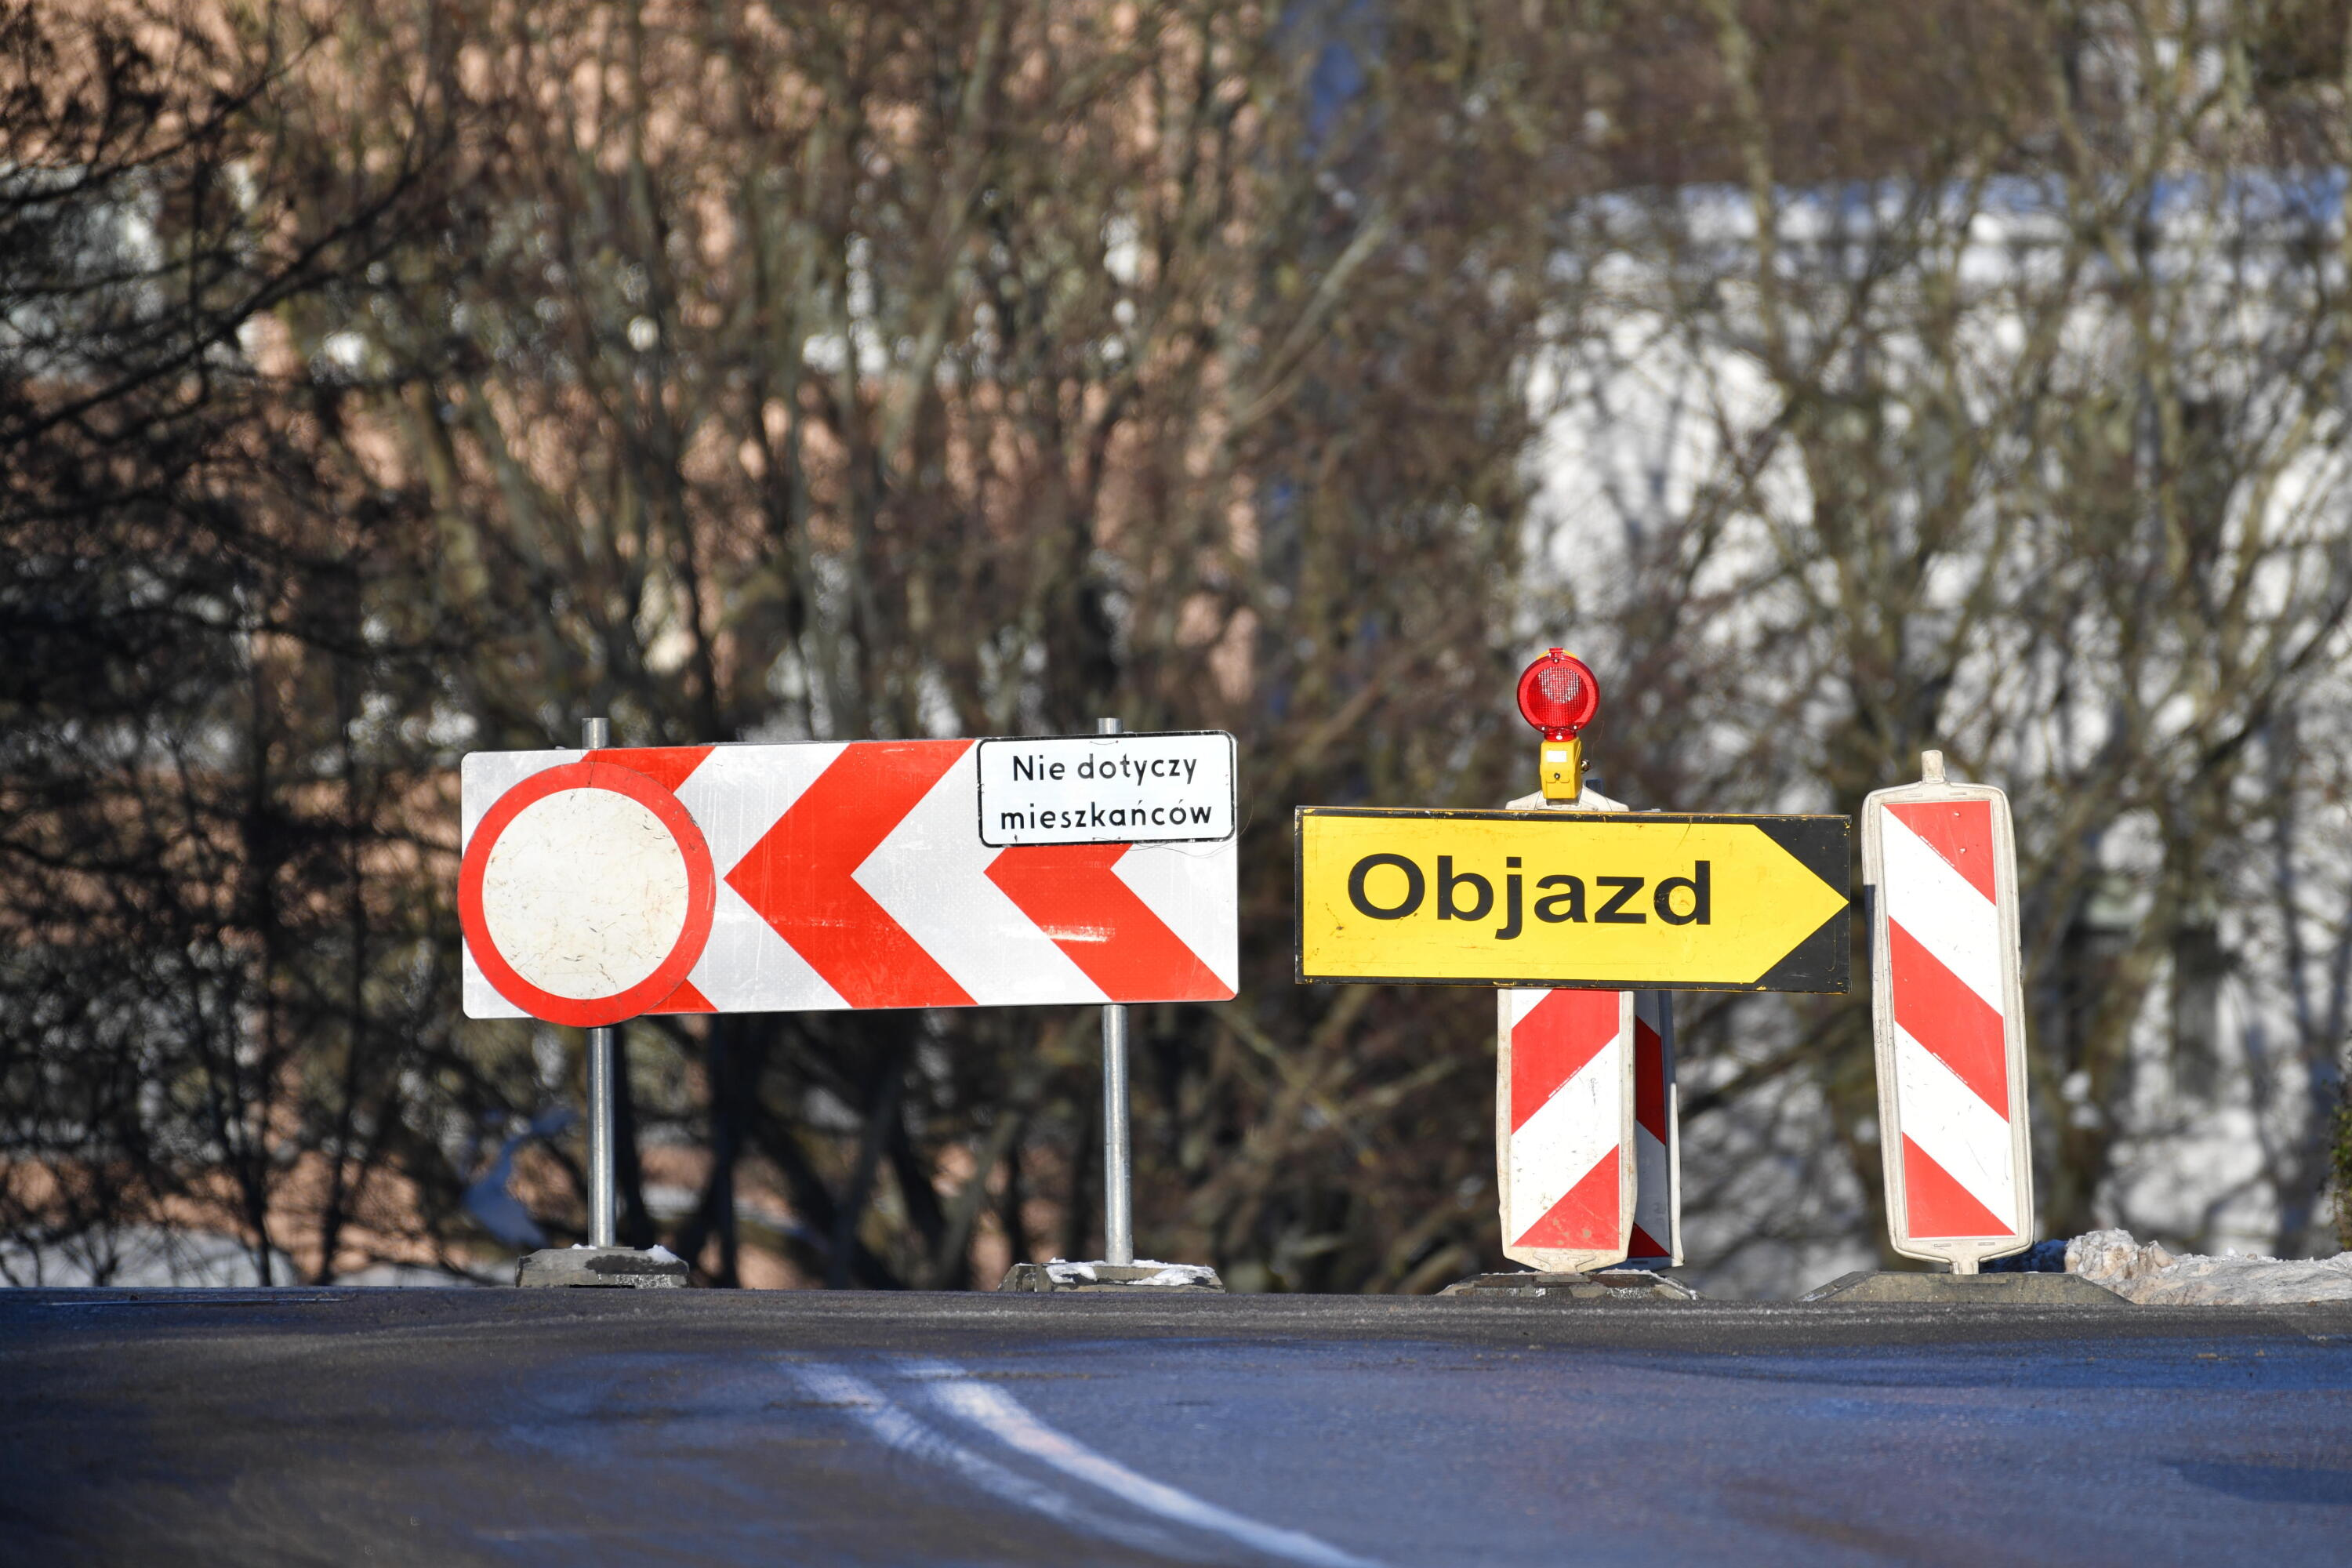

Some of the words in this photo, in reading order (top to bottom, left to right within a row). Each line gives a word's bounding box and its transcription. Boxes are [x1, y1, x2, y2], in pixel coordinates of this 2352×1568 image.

[1013, 754, 1065, 781] Nie
[1078, 753, 1196, 786] dotyczy
[1000, 799, 1211, 829] mieszkańców
[1348, 853, 1711, 940] Objazd
